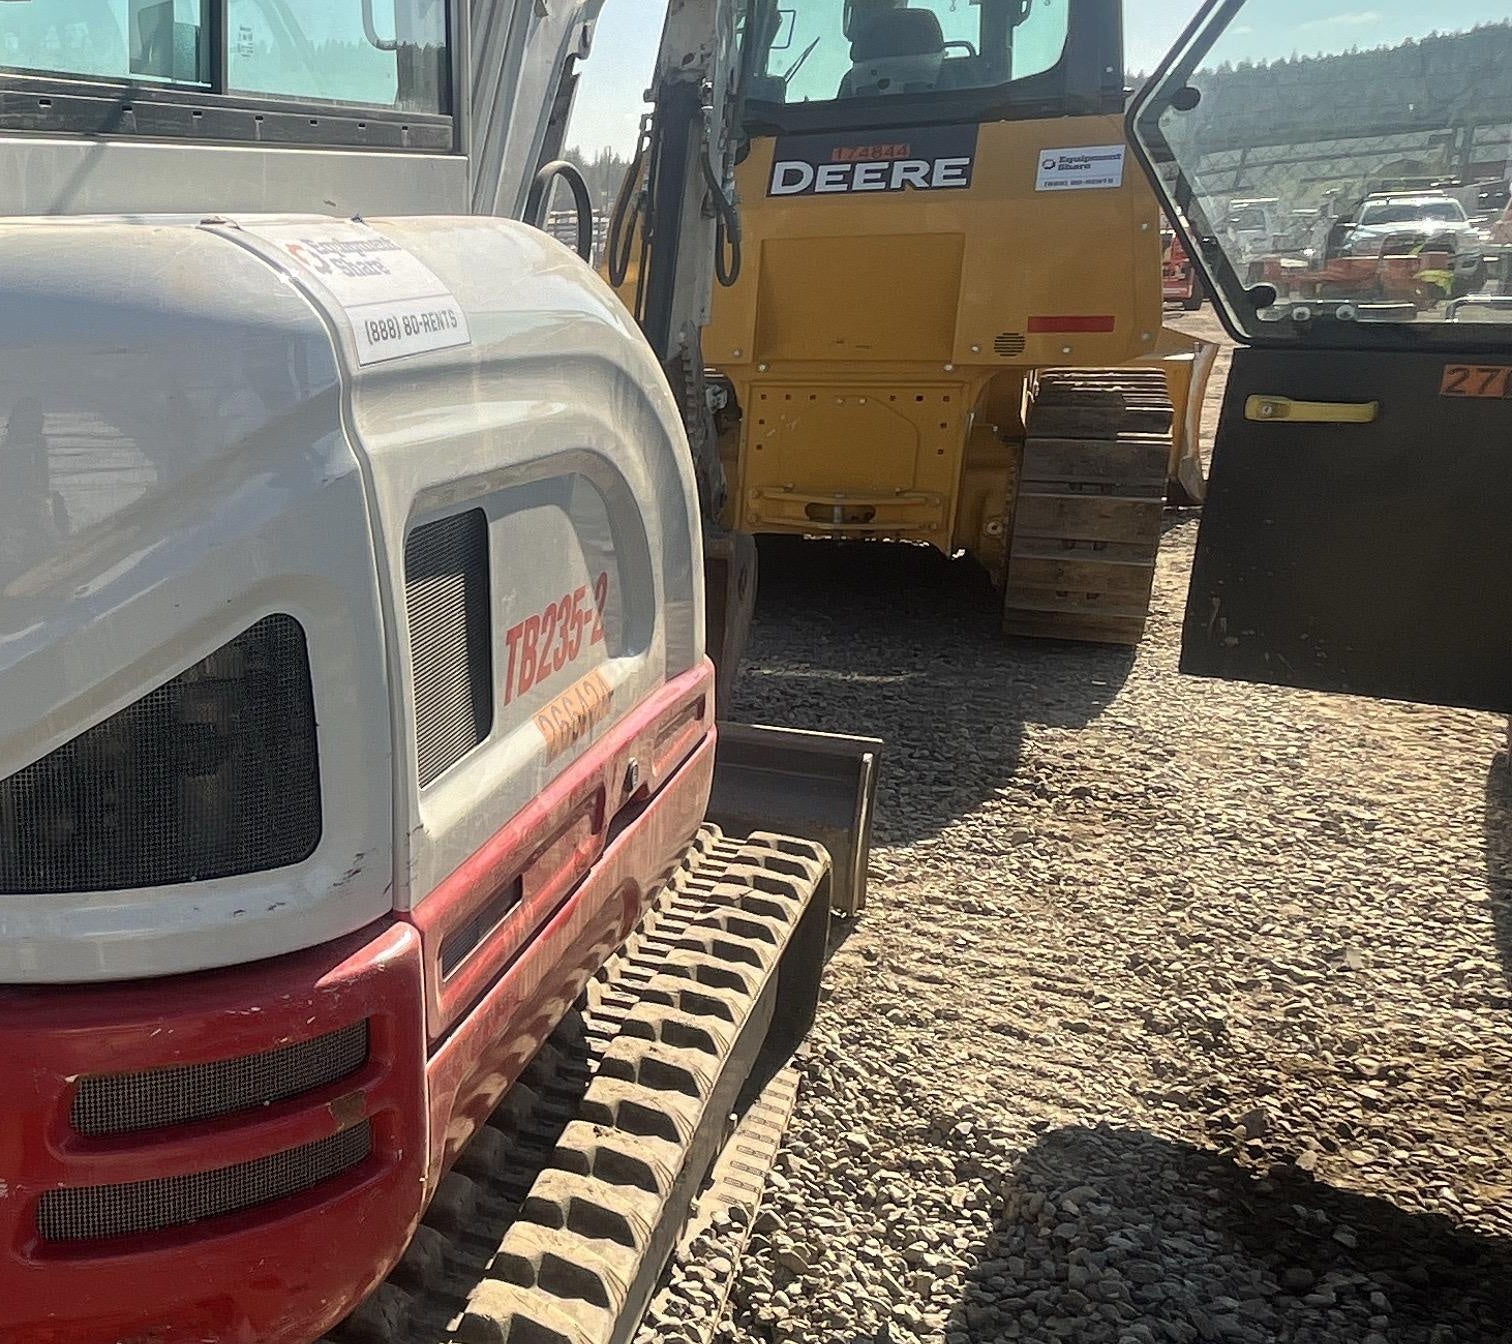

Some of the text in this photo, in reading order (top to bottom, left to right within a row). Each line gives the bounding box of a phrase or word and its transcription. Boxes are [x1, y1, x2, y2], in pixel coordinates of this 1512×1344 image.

[771, 157, 970, 195] DEERE
[365, 309, 458, 345] (888) 80-RENTS
[504, 571, 608, 707] TB235-2
